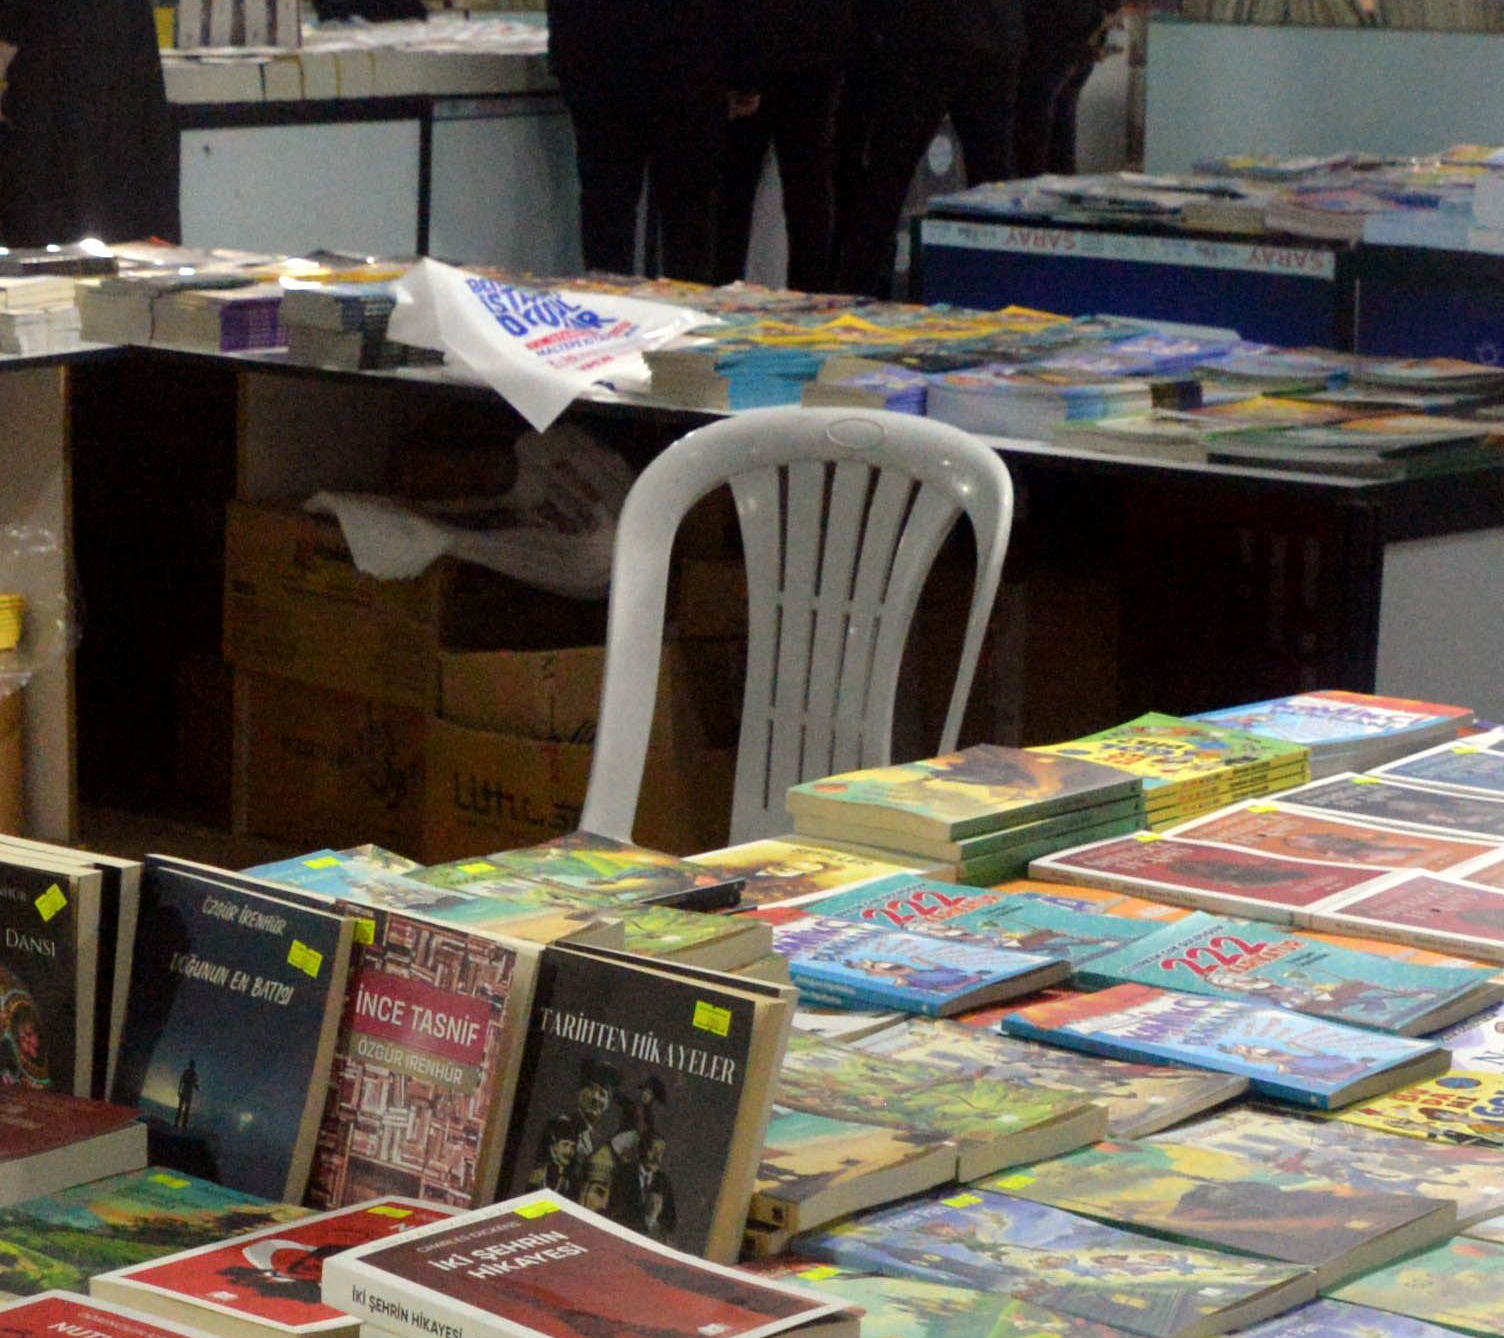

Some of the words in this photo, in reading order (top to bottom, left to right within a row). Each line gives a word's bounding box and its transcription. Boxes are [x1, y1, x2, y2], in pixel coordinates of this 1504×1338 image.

[5, 925, 57, 959] DANSI
[1161, 936, 1269, 976] 222
[355, 984, 406, 1029] İNCE
[409, 1002, 481, 1048] TASNİF
[357, 1039, 402, 1071] ÖZGÜR
[404, 1049, 464, 1087] İRENHÜR
[541, 1005, 627, 1055] TARİHTEN
[631, 1022, 737, 1086] HİKAYELER
[428, 1253, 467, 1272] İKİ
[471, 1229, 571, 1261] ŞEHRİN
[467, 1241, 590, 1280] HİKAYESİ
[352, 1284, 366, 1305] İKİ
[369, 1295, 409, 1323] ŞEHRİN
